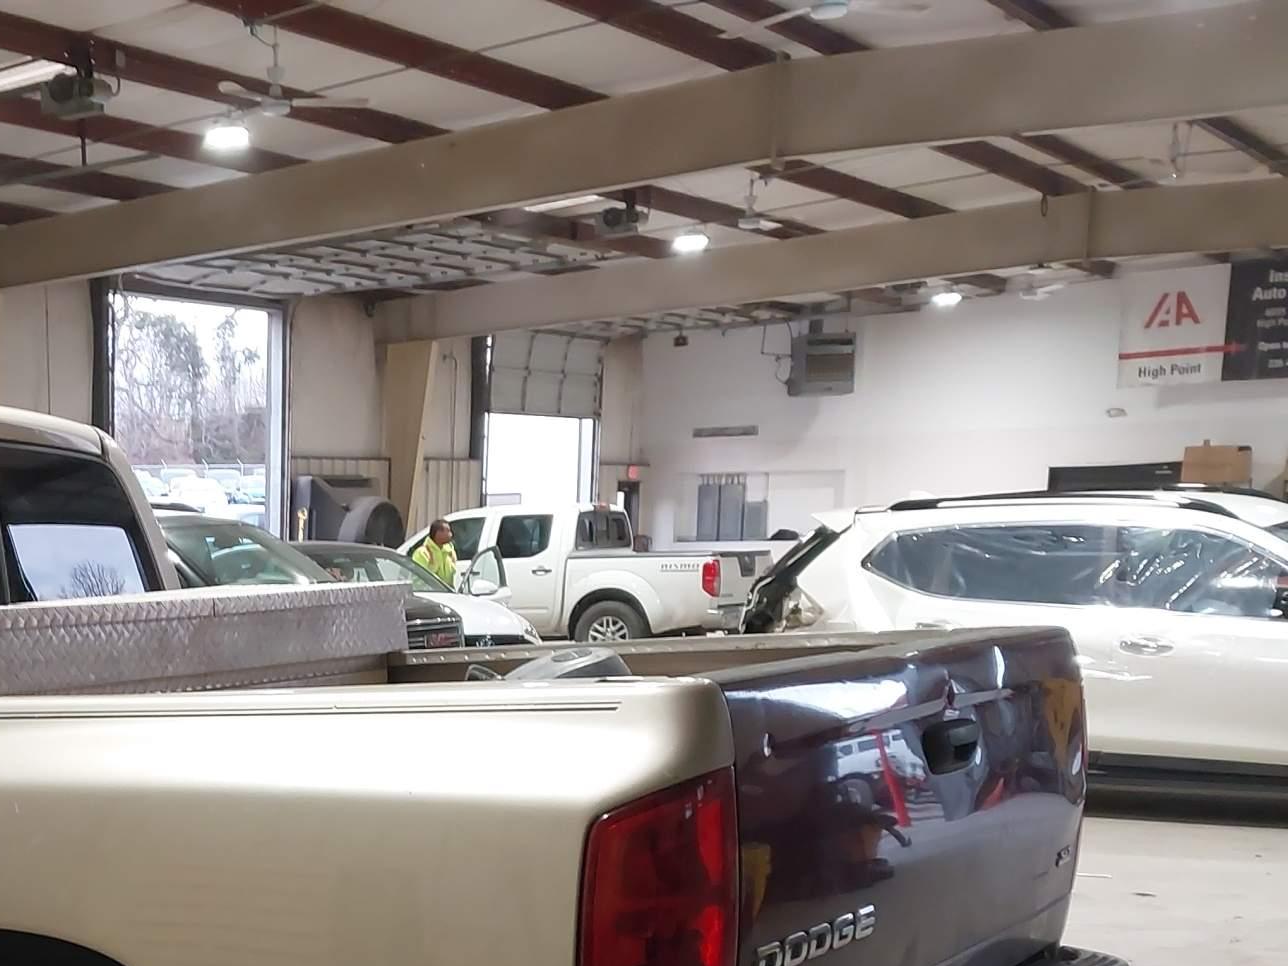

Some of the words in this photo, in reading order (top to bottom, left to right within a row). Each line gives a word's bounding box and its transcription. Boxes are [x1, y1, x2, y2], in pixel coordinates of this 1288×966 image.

[1252, 286, 1287, 300] Auto
[1138, 365, 1166, 379] High
[1170, 363, 1201, 376] Point
